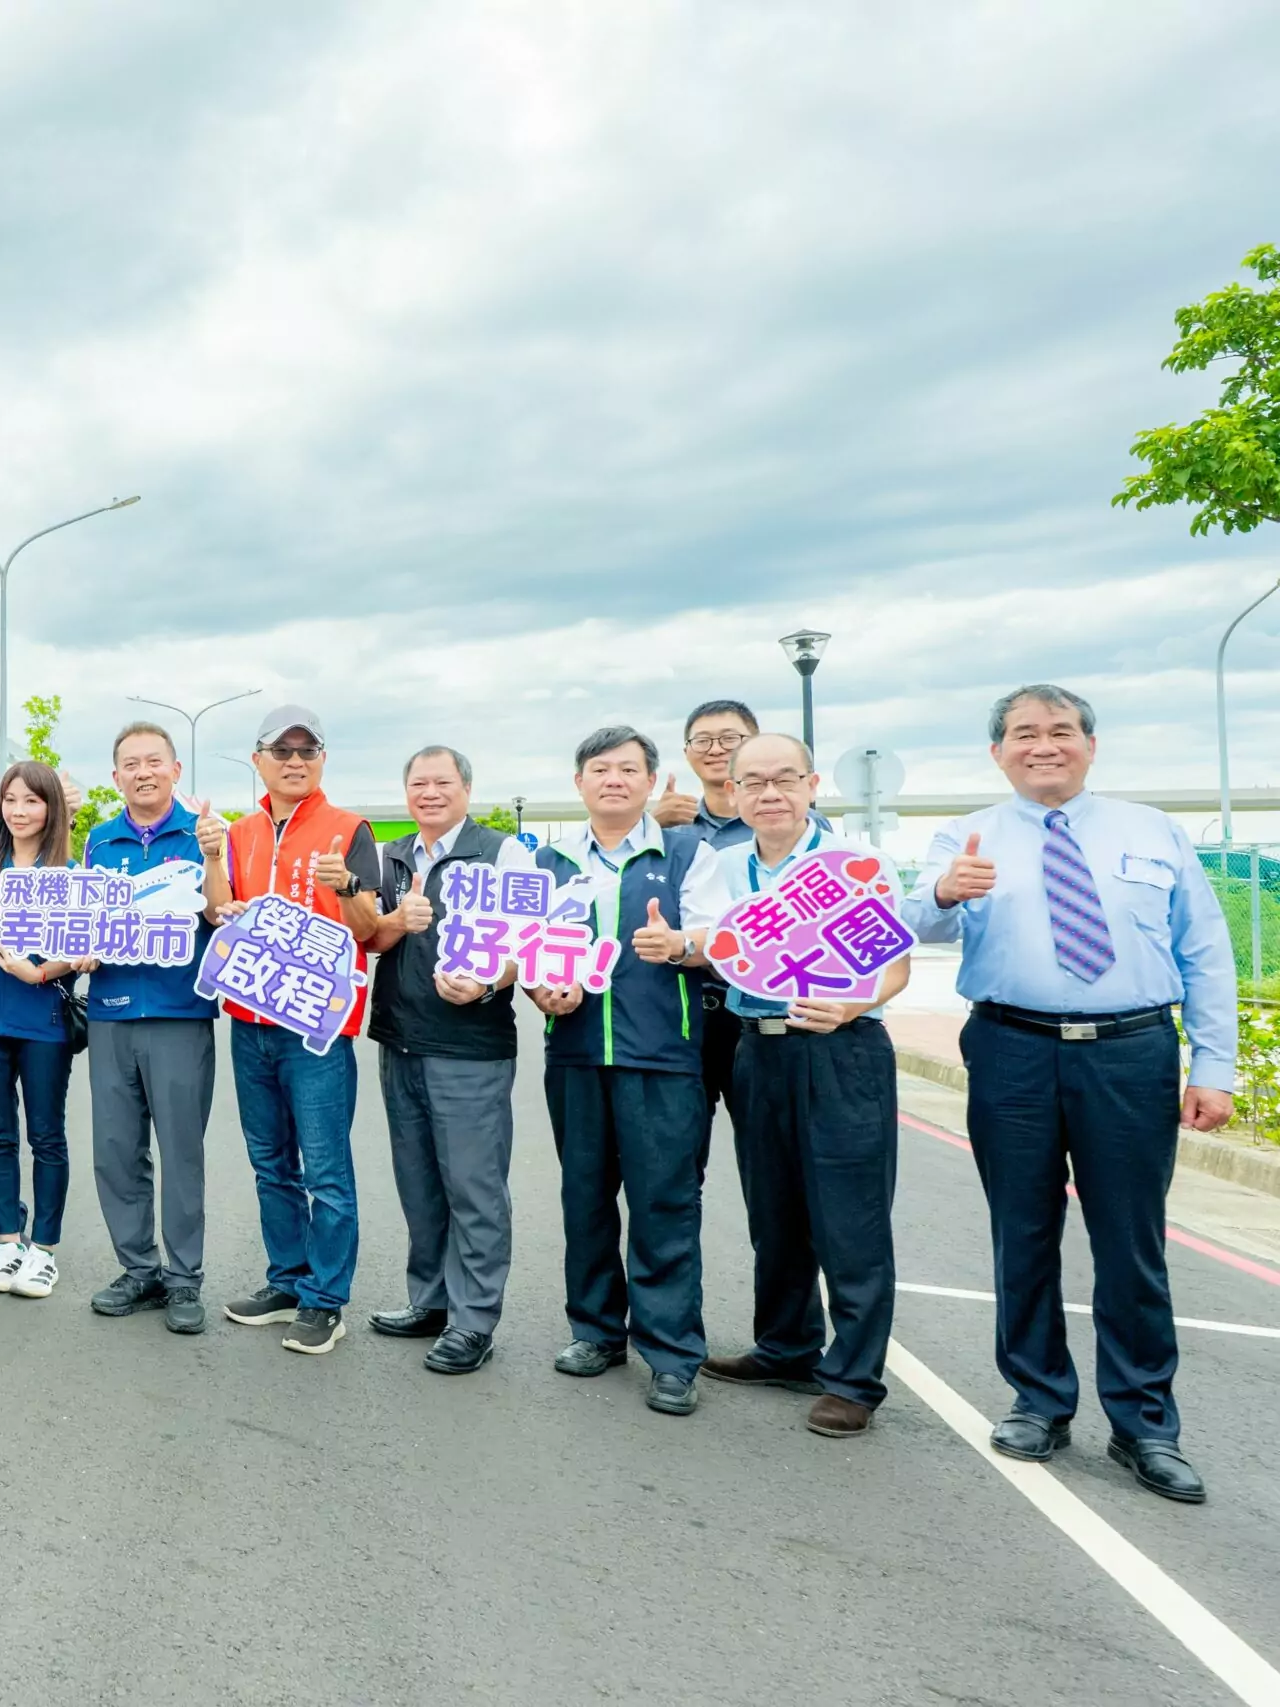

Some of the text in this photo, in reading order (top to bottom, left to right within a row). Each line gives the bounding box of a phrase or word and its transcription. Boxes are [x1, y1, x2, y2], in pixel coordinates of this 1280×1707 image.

[3, 873, 132, 906] 飛機下的
[304, 851, 319, 912] 桃園市政府新
[446, 866, 550, 917] 桃園
[736, 862, 848, 948] 幸福
[0, 909, 192, 960] 幸福城市
[250, 898, 348, 973] 榮景
[441, 915, 616, 988] 好行!
[766, 897, 914, 999] 大園
